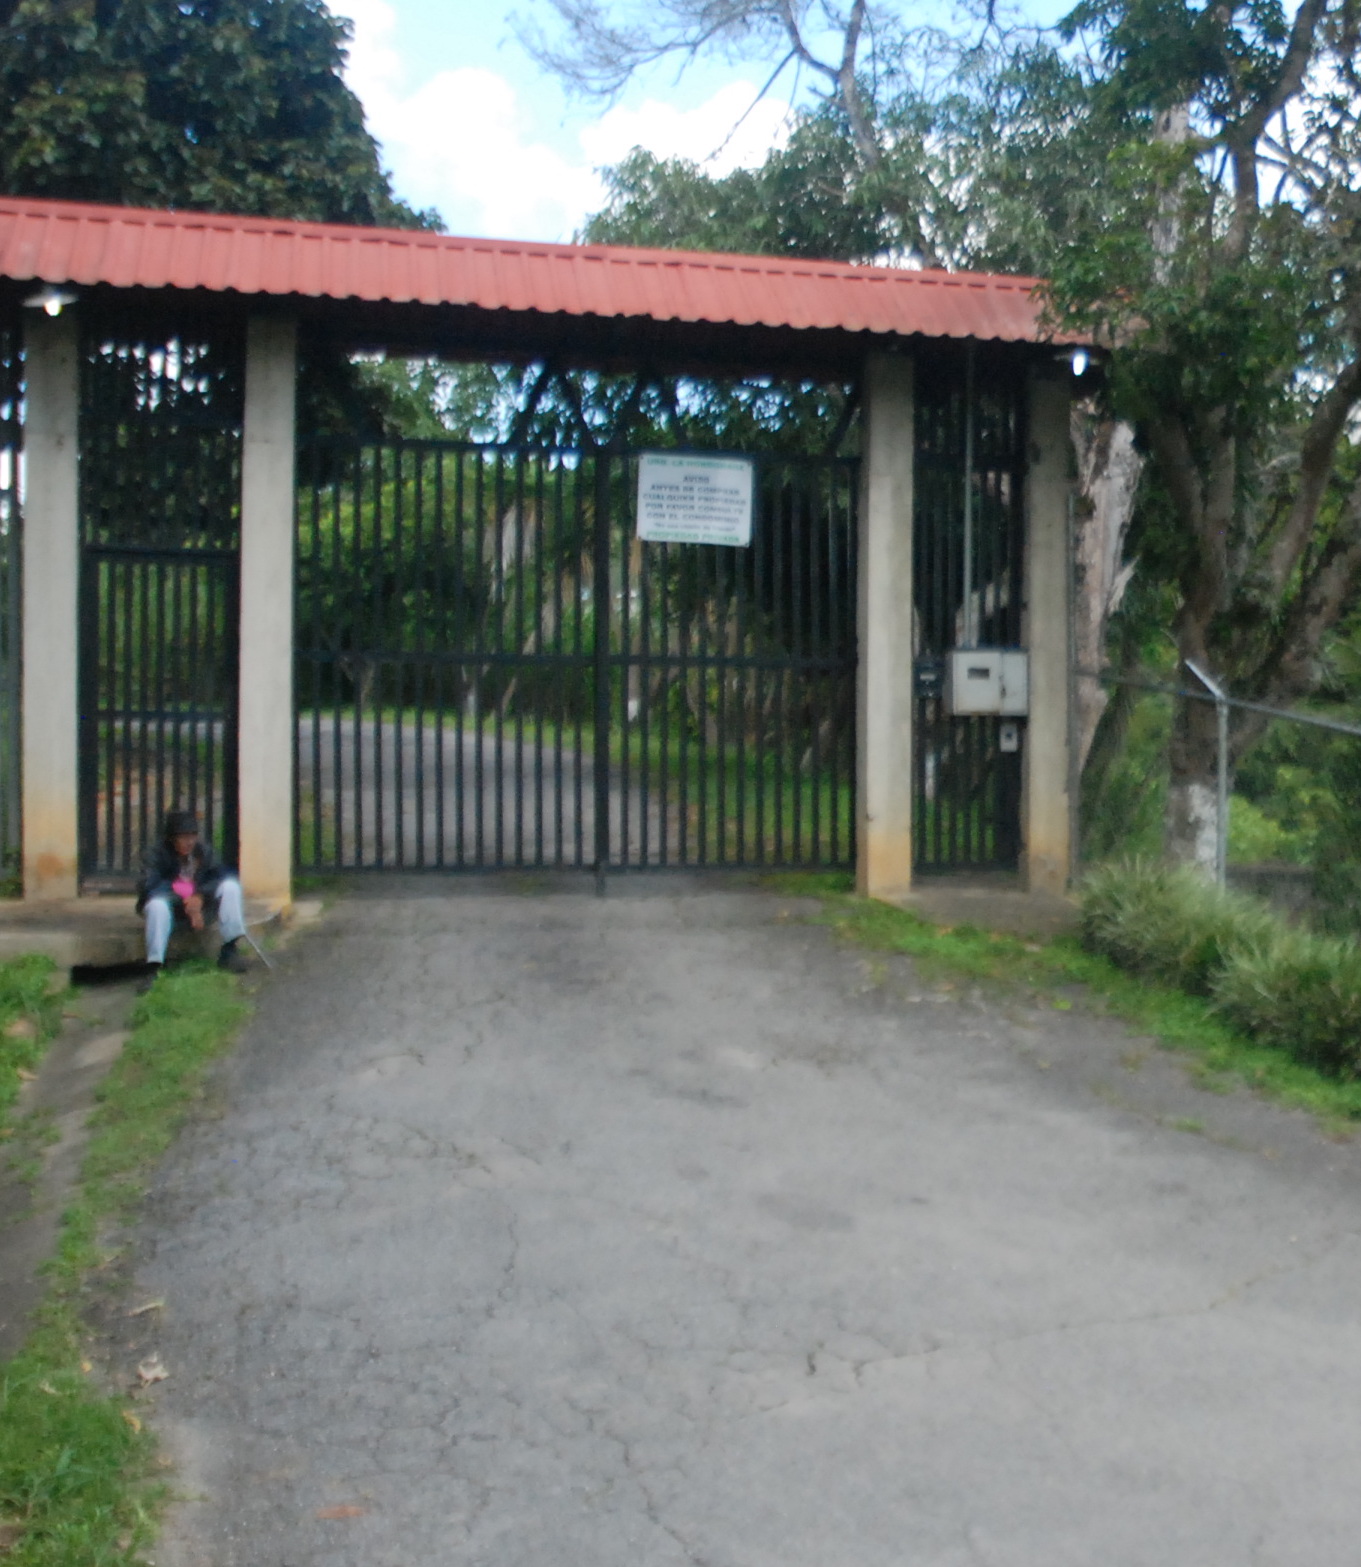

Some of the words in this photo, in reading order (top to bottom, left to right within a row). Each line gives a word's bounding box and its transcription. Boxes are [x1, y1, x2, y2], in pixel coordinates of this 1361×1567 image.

[683, 475, 709, 483] AVISO
[683, 485, 694, 493] DE
[698, 486, 739, 495] COMPRAR
[643, 493, 695, 502] CUALQUIER
[698, 496, 746, 506] PROPIEDAD
[645, 502, 663, 510] POR
[667, 503, 695, 511] FAVOR
[698, 505, 743, 514] CONSULTE
[682, 513, 739, 523] CONDOMINIO
[647, 531, 699, 539] PROPIEDAD
[702, 534, 739, 542] PRIVADA
